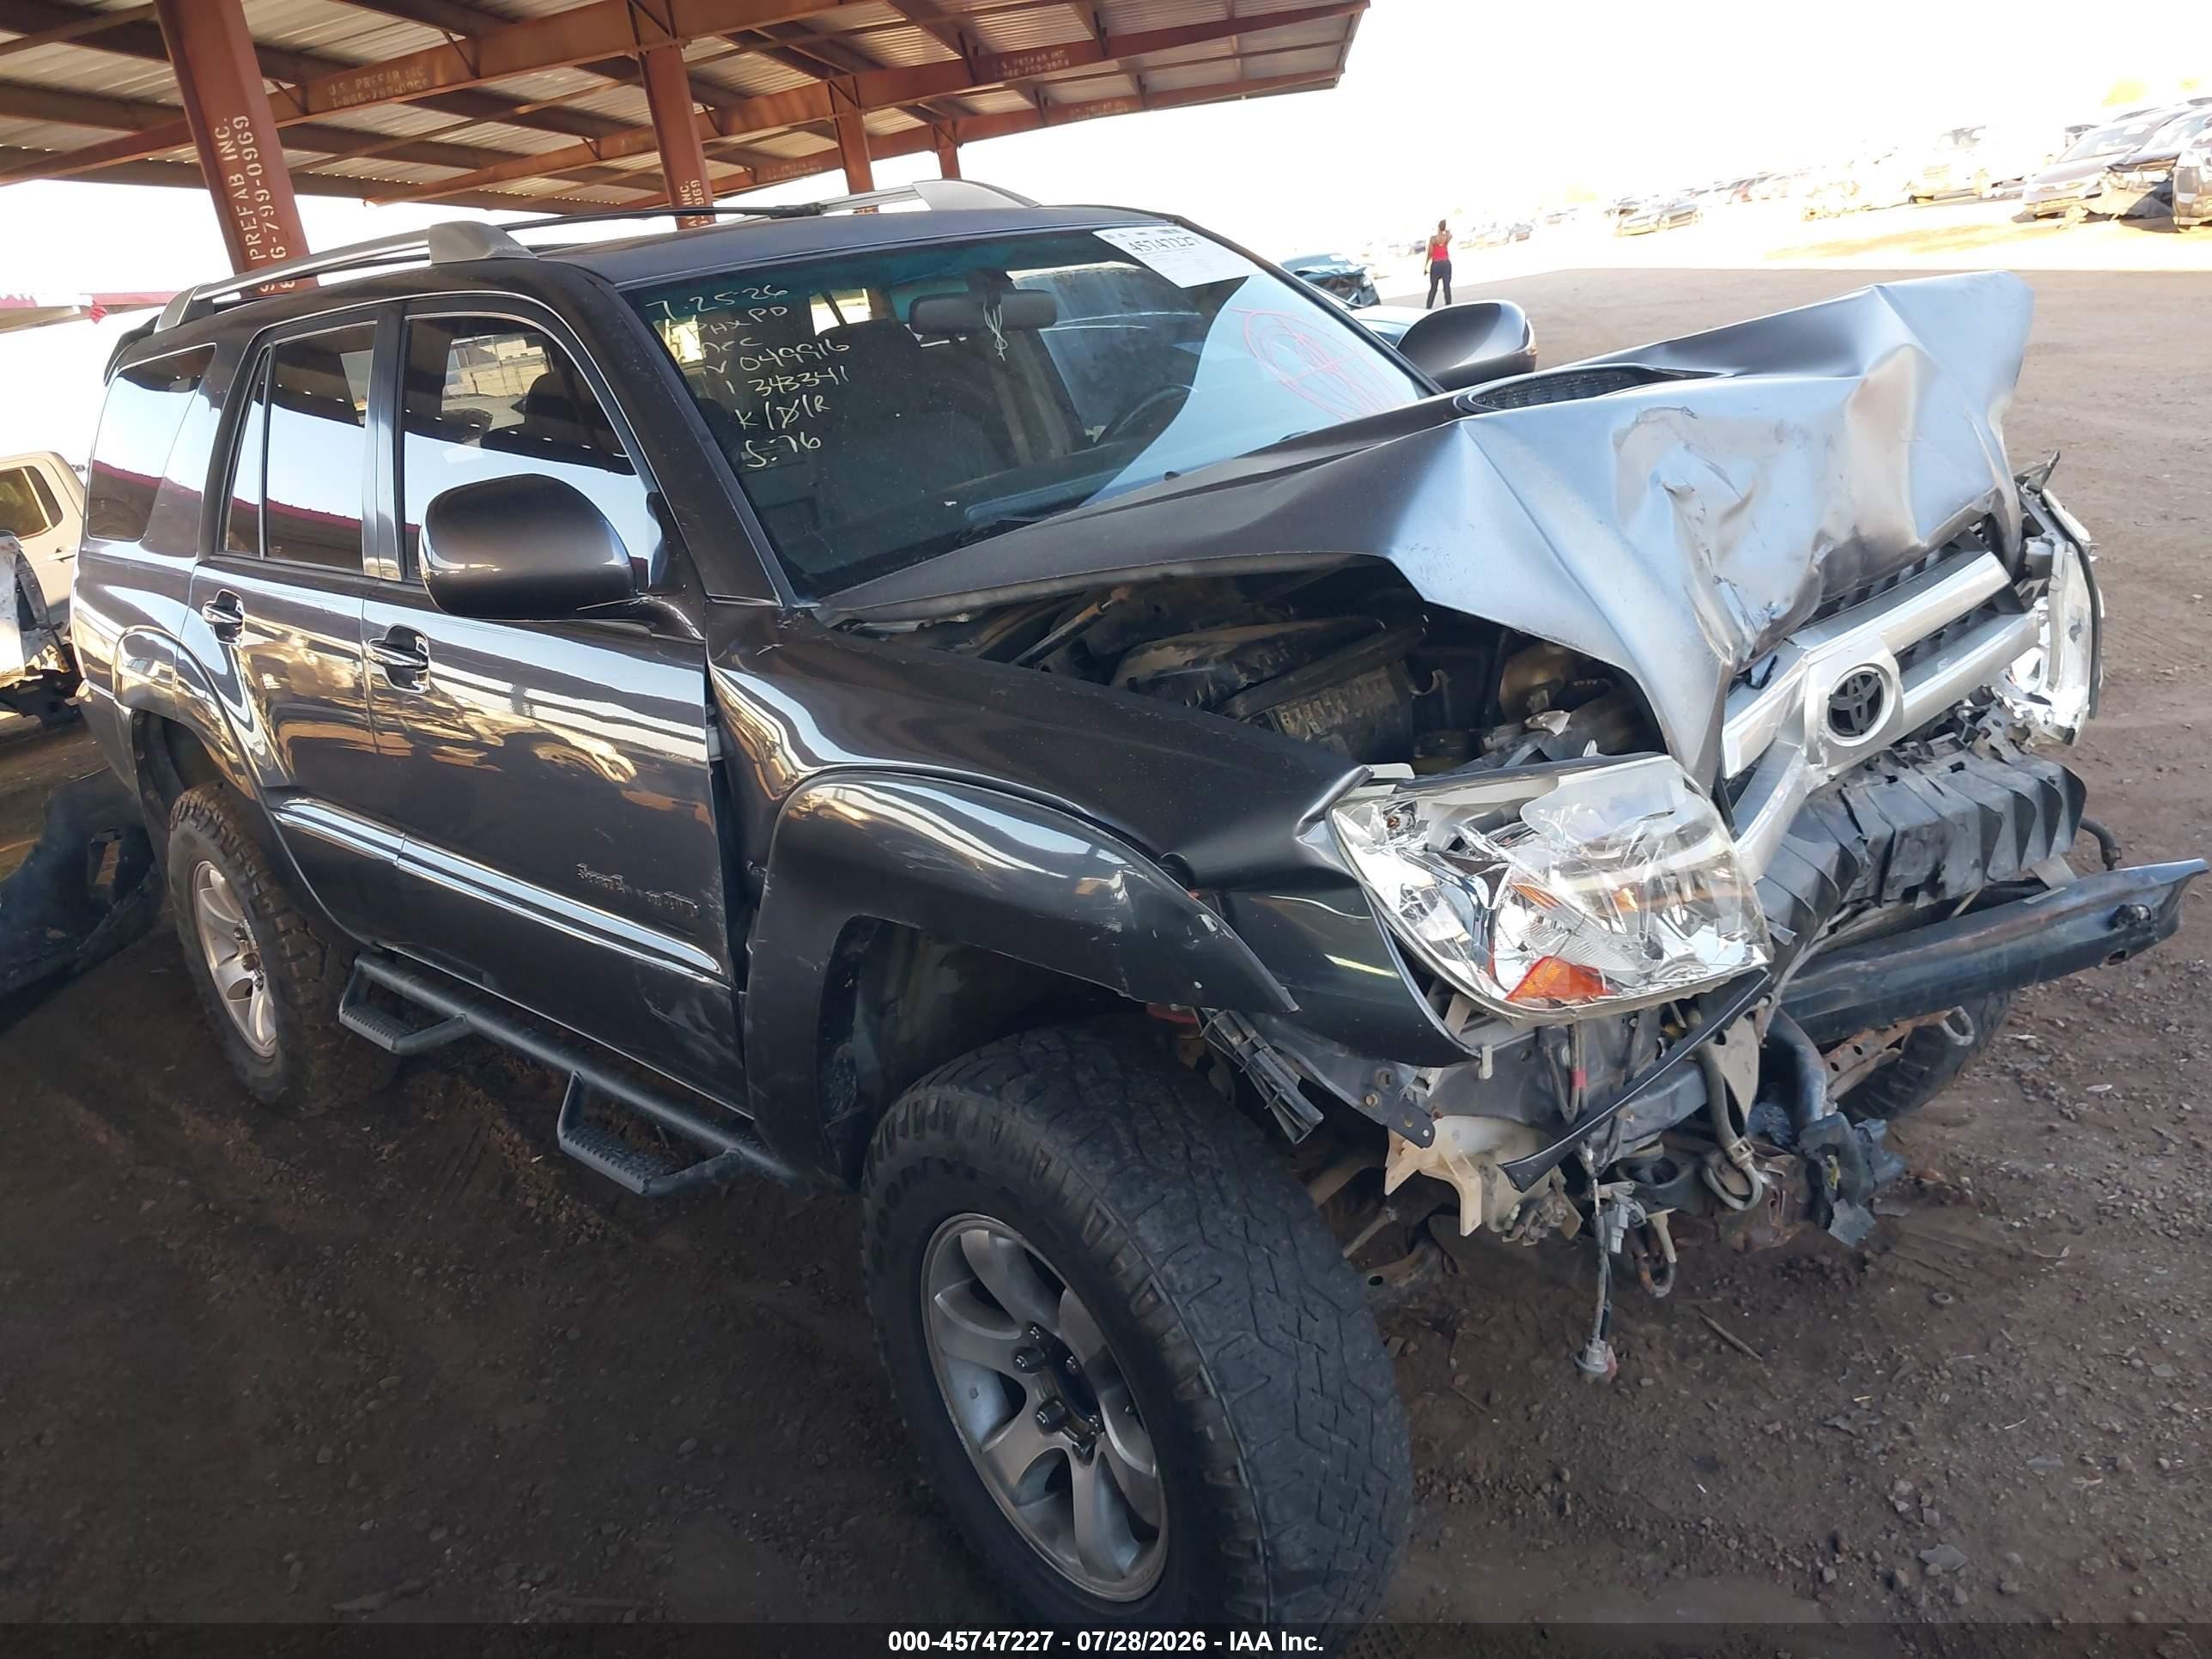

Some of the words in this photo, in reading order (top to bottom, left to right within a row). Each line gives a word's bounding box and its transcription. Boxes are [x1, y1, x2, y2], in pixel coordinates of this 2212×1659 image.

[215, 117, 238, 161] INC.
[228, 173, 266, 260] PREFAB
[748, 307, 788, 323] PD
